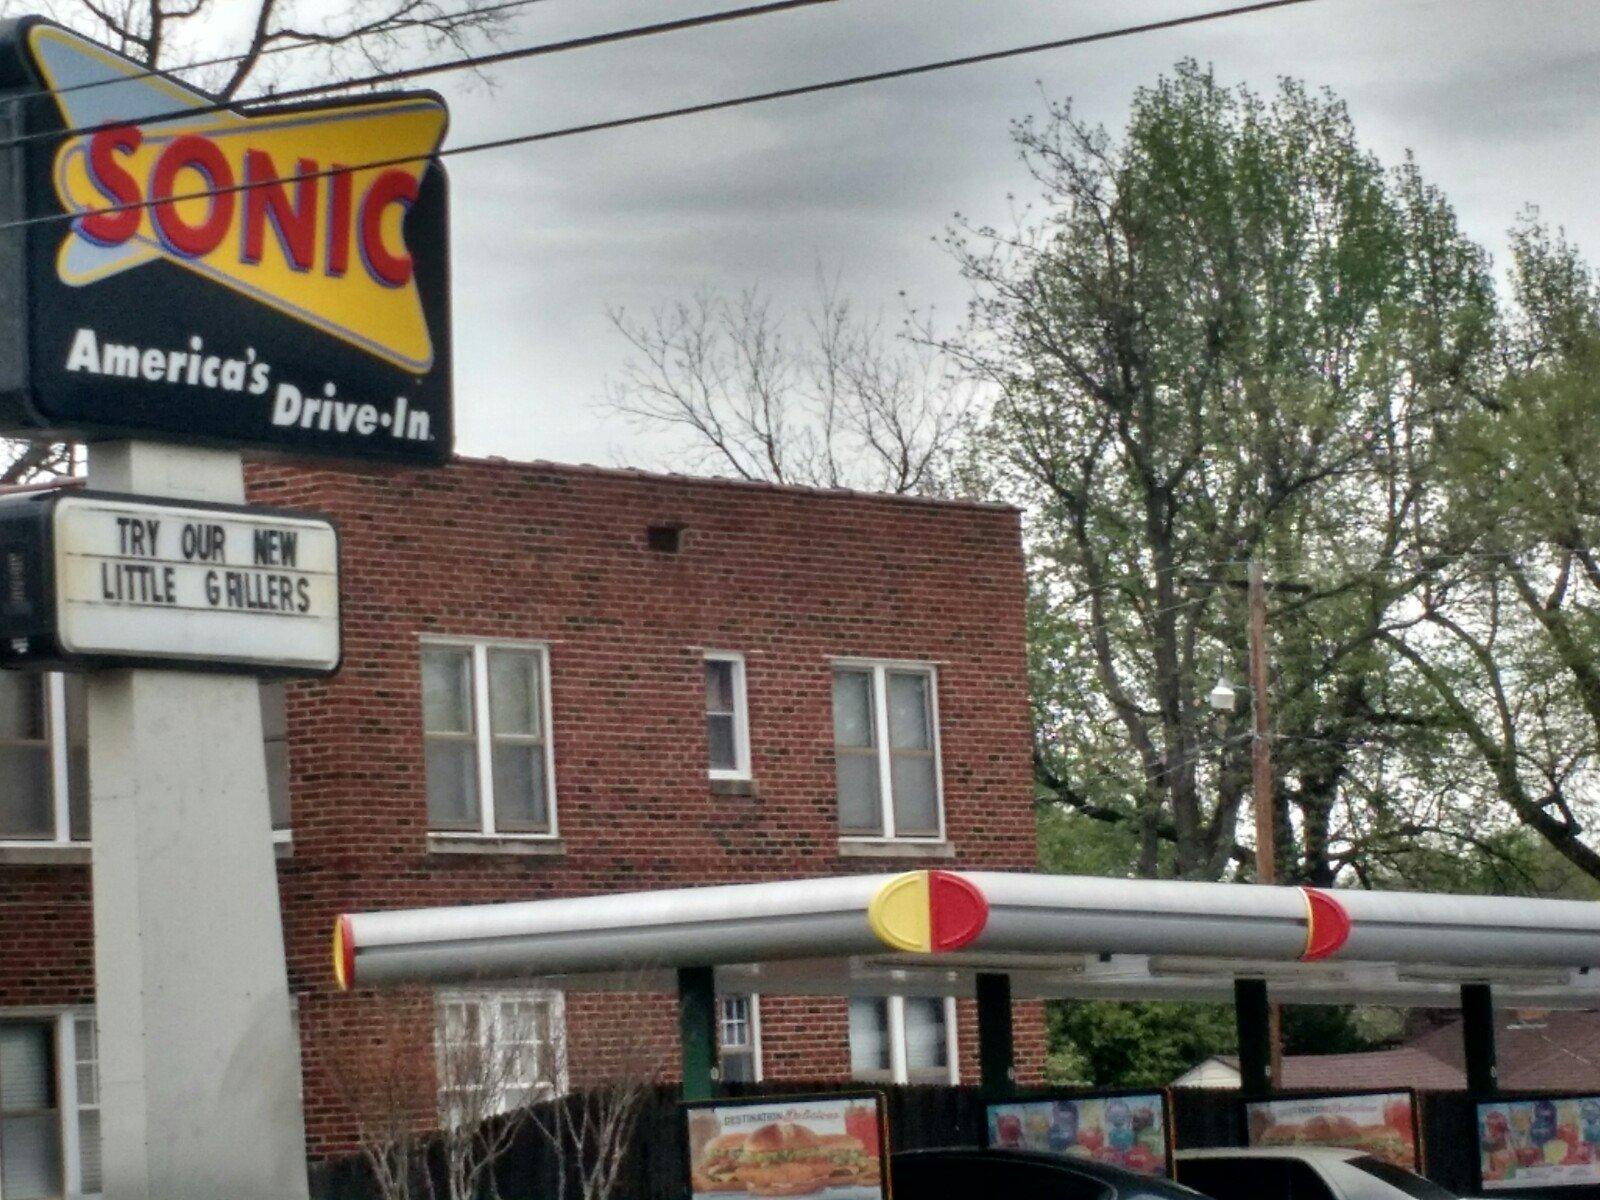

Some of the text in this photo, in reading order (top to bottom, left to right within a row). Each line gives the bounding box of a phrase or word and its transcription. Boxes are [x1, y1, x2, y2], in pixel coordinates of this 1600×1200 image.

[71, 120, 419, 290] SONIC
[66, 327, 271, 395] America's
[117, 517, 298, 568] TRY OUR NEW
[102, 562, 311, 614] LITTLE GRILLERS
